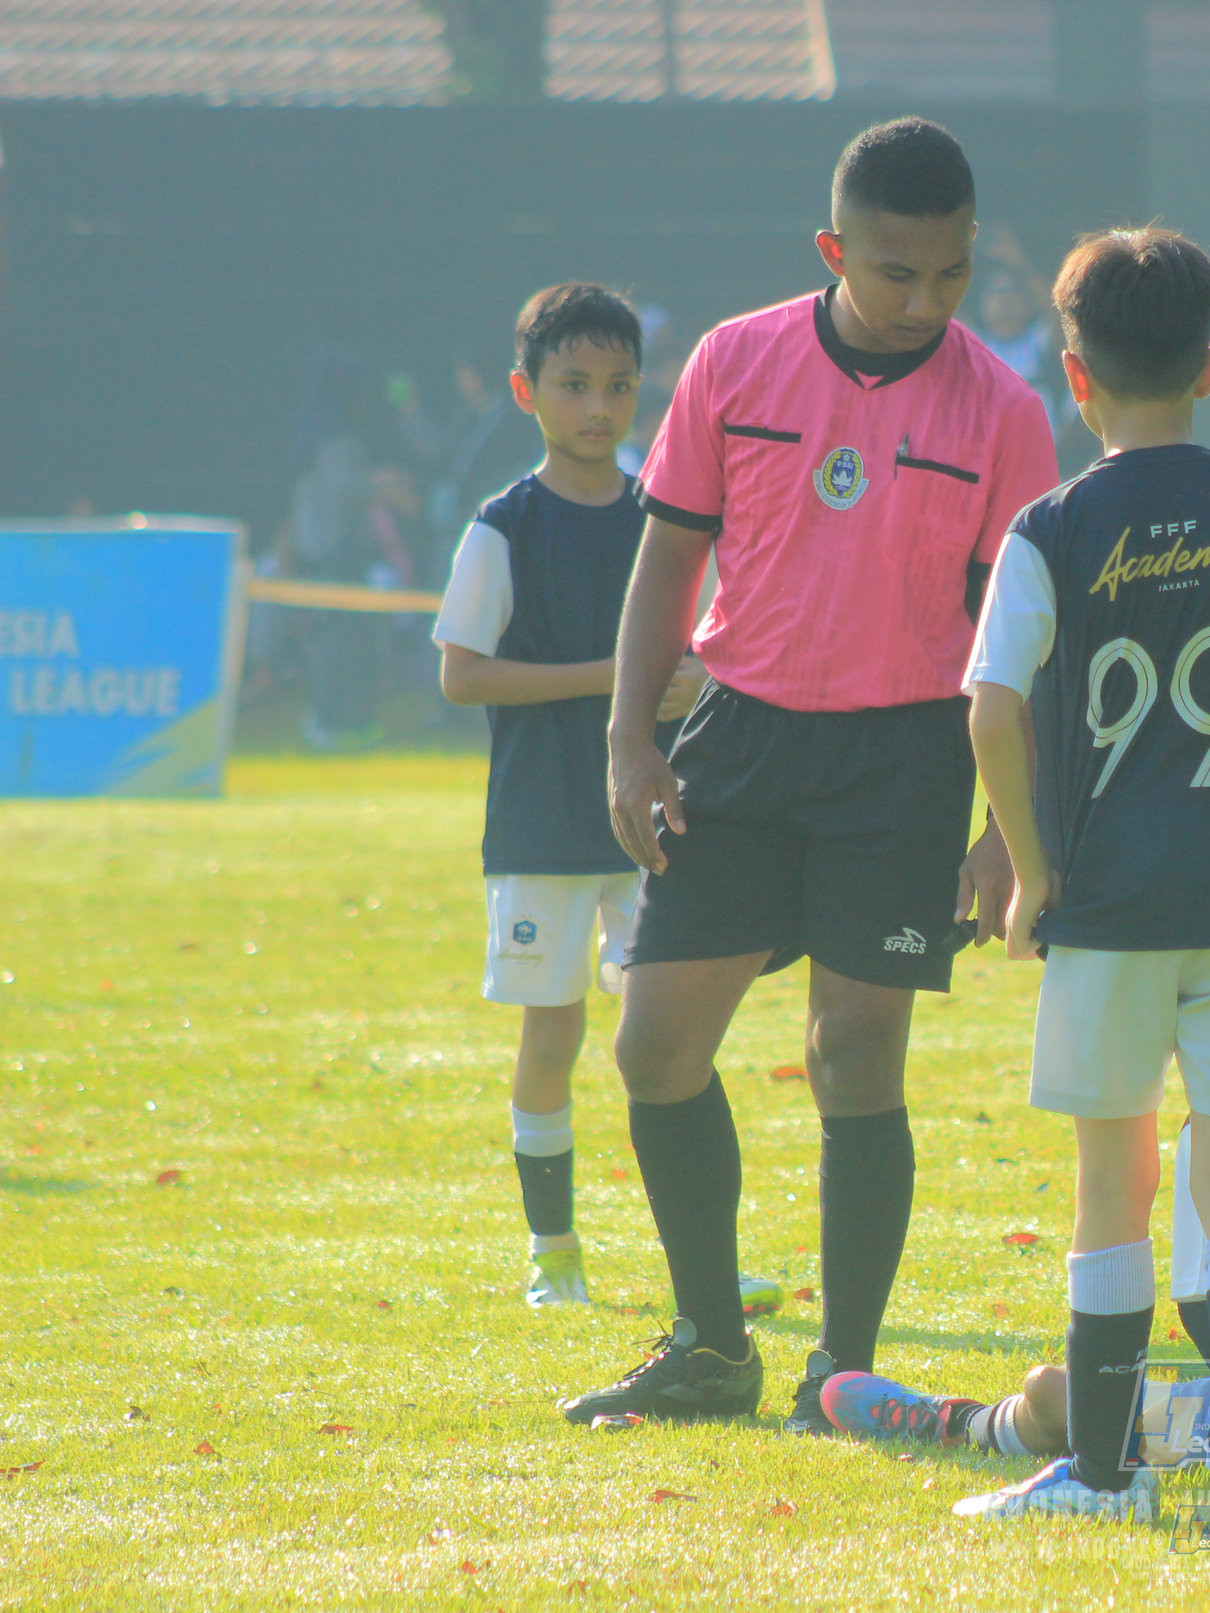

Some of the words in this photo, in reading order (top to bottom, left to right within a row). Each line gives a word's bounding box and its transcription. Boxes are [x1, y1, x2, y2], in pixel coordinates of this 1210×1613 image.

[1150, 520, 1197, 539] FFF
[1158, 579, 1200, 592] JAKARTA
[12, 665, 179, 717] LEAGUE
[884, 940, 927, 955] SPECS
